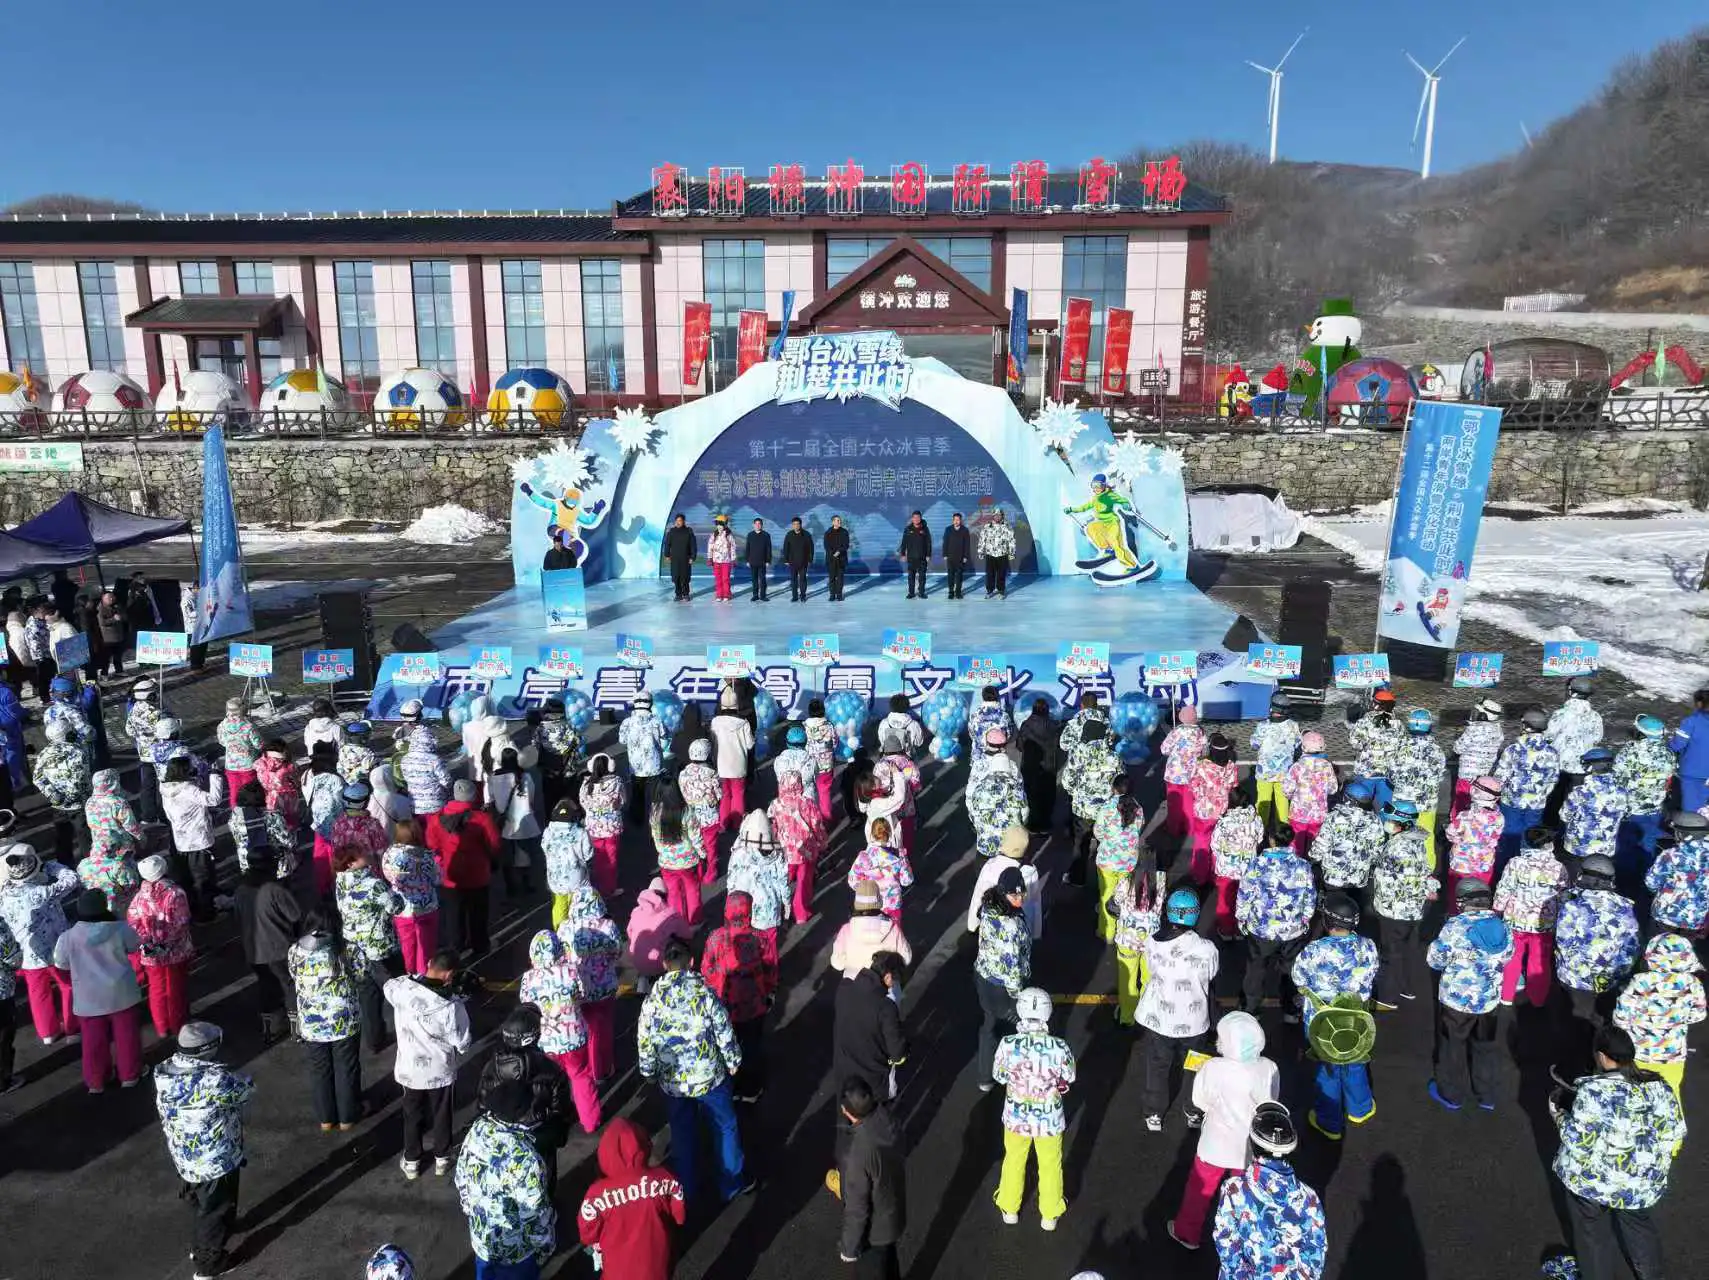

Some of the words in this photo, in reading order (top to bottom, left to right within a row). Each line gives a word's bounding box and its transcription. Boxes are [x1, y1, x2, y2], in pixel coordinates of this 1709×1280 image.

[653, 156, 1187, 209] 襄阳横冲国际滑雪场
[860, 290, 950, 309] 横冲欢迎您
[1188, 289, 1202, 341] 旅游餐厅
[783, 337, 904, 366] 鄂台冰雪缘
[776, 362, 913, 397] 荆楚共此时
[749, 437, 950, 459] 第十二届全国大众冰雪季
[1066, 656, 1099, 667] 第九组
[1252, 658, 1298, 669] 第十三组
[967, 669, 998, 680] 第七组
[1150, 667, 1193, 676] 第十一组
[1340, 669, 1386, 680] 第十五组
